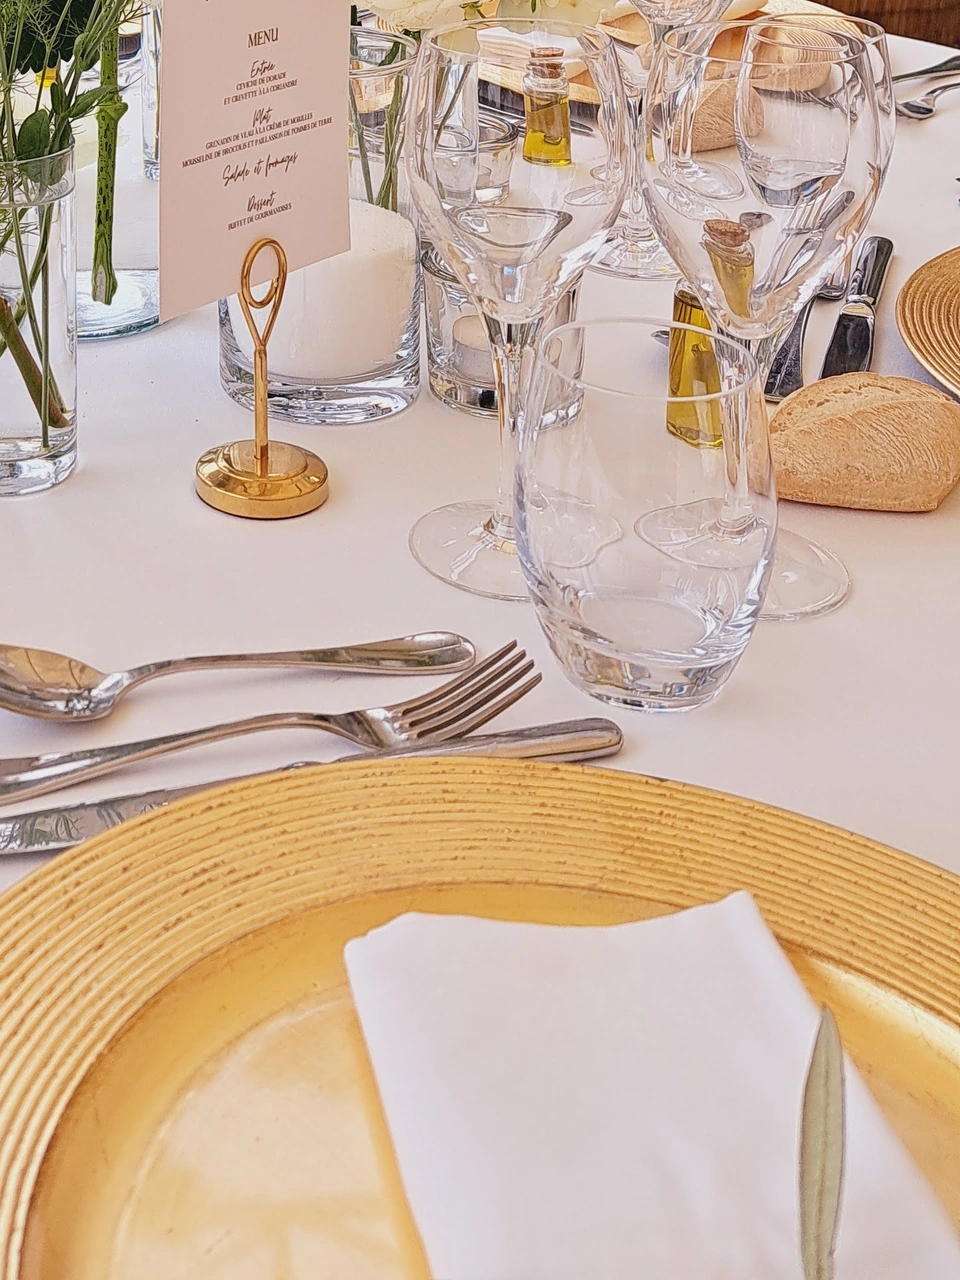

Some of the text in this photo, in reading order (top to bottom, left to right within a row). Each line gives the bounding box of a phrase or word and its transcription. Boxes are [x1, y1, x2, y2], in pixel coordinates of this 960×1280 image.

[247, 26, 280, 49] MENU
[258, 76, 266, 86] DE
[223, 96, 231, 106] ET
[262, 86, 270, 95] LA
[252, 106, 273, 128] Plat
[213, 149, 221, 159] DE
[247, 139, 255, 148] ET
[283, 128, 291, 138] DE
[310, 120, 318, 130] DE
[233, 132, 240, 142] DE
[259, 126, 266, 134] LA
[282, 118, 290, 127] DE
[222, 151, 299, 187] Salade et fromages
[246, 189, 277, 212] Dessert
[246, 215, 254, 224] DE
